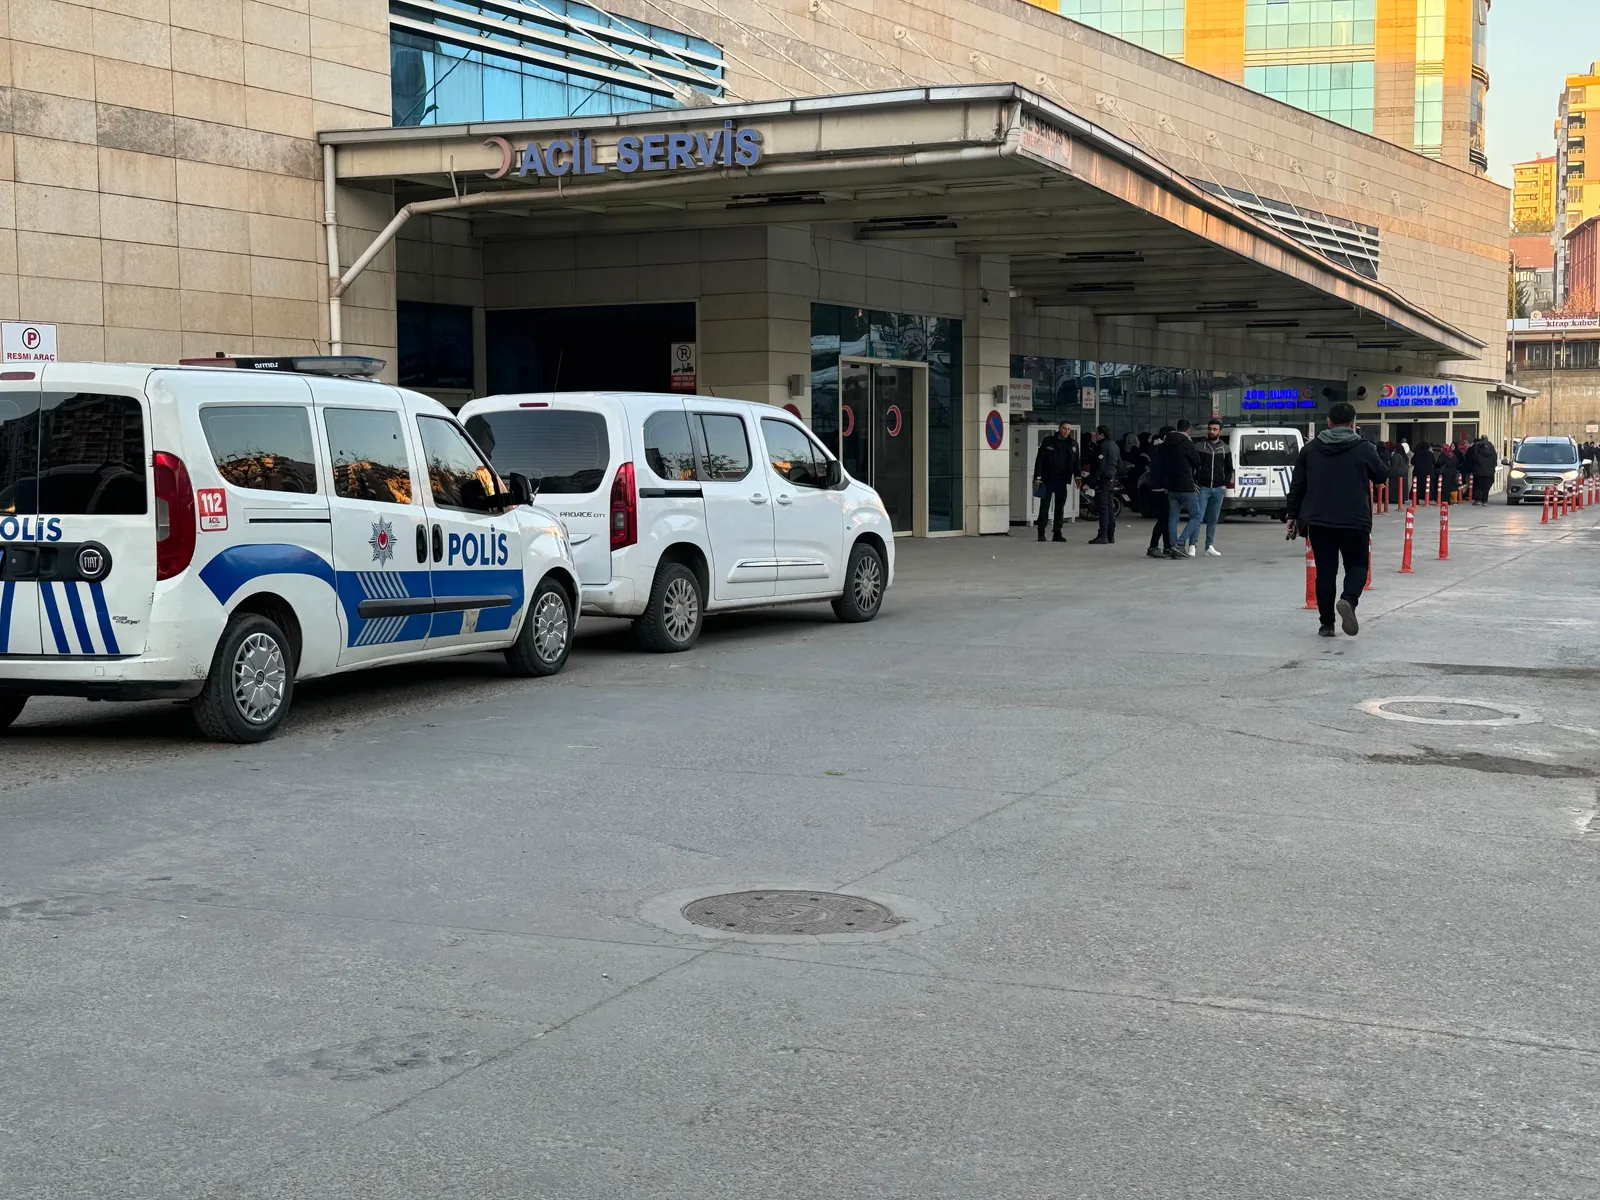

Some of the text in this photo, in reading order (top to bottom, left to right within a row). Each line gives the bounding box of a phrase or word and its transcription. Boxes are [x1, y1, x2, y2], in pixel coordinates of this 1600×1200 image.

[519, 120, 763, 177] ACİL SERVİS
[33, 354, 55, 362] ARAÇ
[1254, 440, 1285, 451] POLİS
[201, 492, 224, 513] 112
[0, 516, 63, 541] OLİS
[448, 524, 509, 567] POLİS
[83, 556, 98, 569] FIAT
